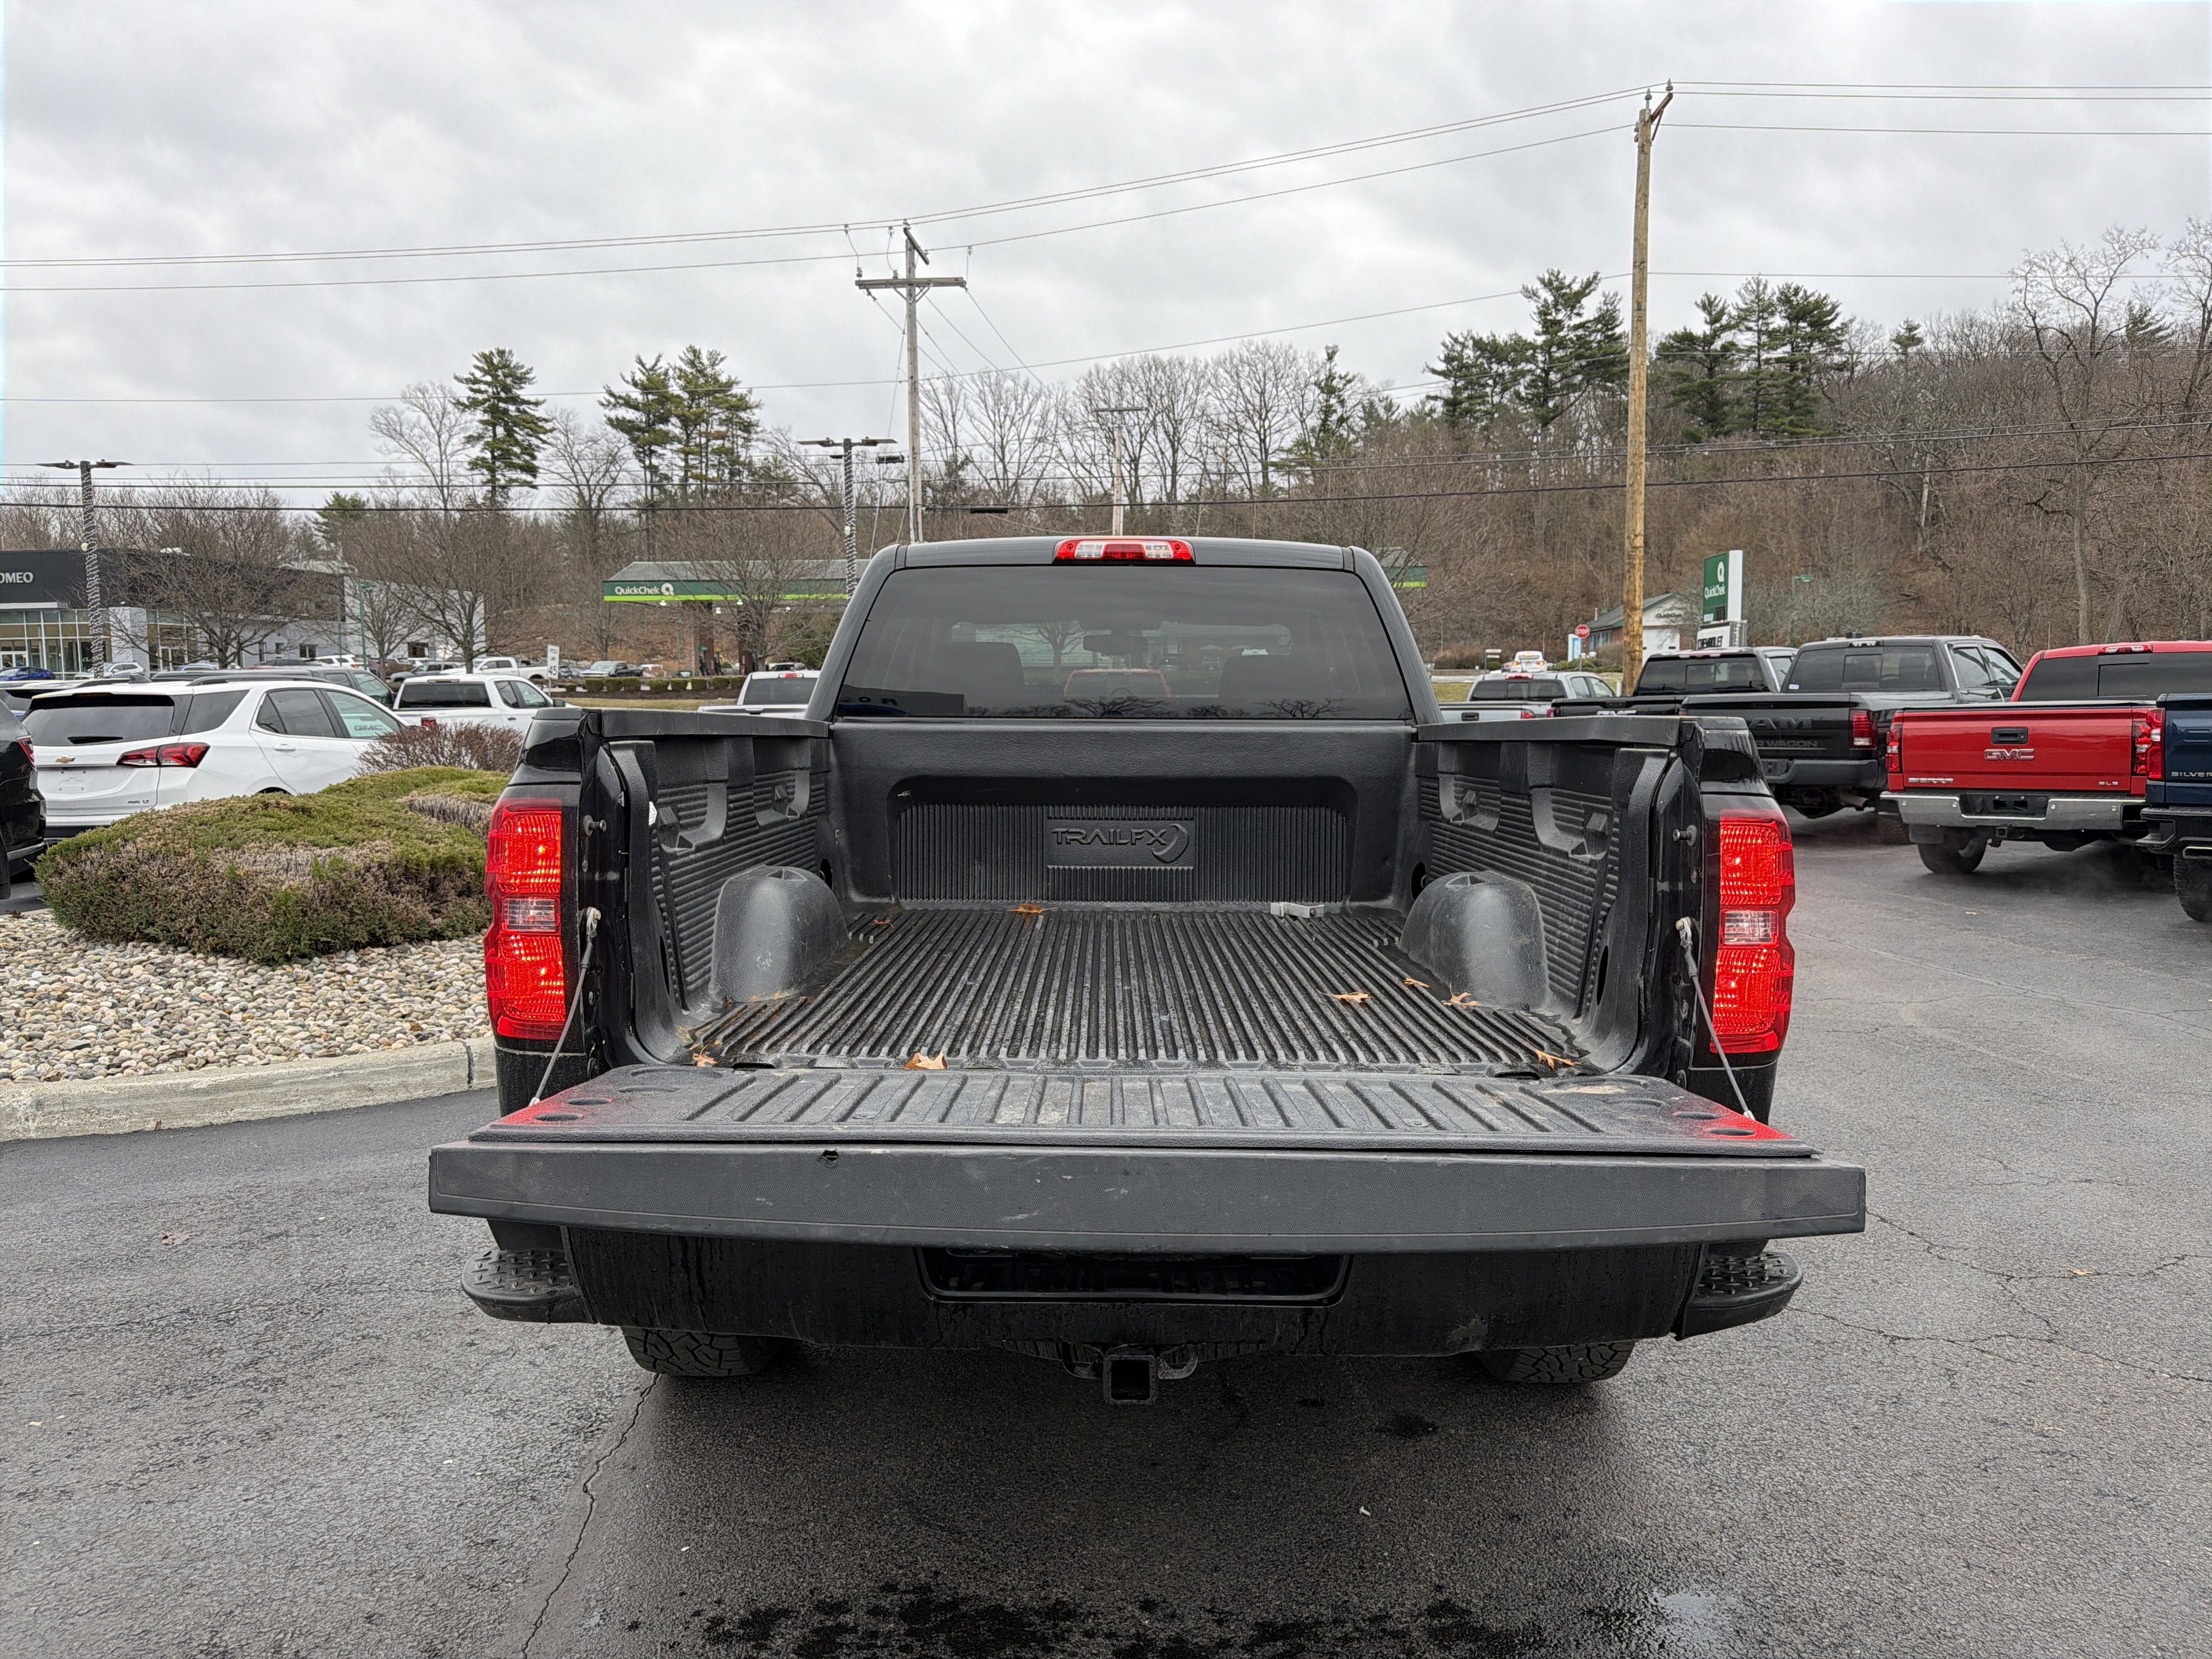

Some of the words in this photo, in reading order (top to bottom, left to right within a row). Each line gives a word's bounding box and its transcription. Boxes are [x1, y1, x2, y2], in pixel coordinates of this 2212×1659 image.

[614, 585, 659, 595] QuickChek
[1704, 583, 1725, 600] QuickChek
[549, 665, 557, 676] 45
[1749, 718, 1812, 730] AM
[1984, 748, 2035, 760] GMC
[1052, 827, 1167, 845] TRAILFX
